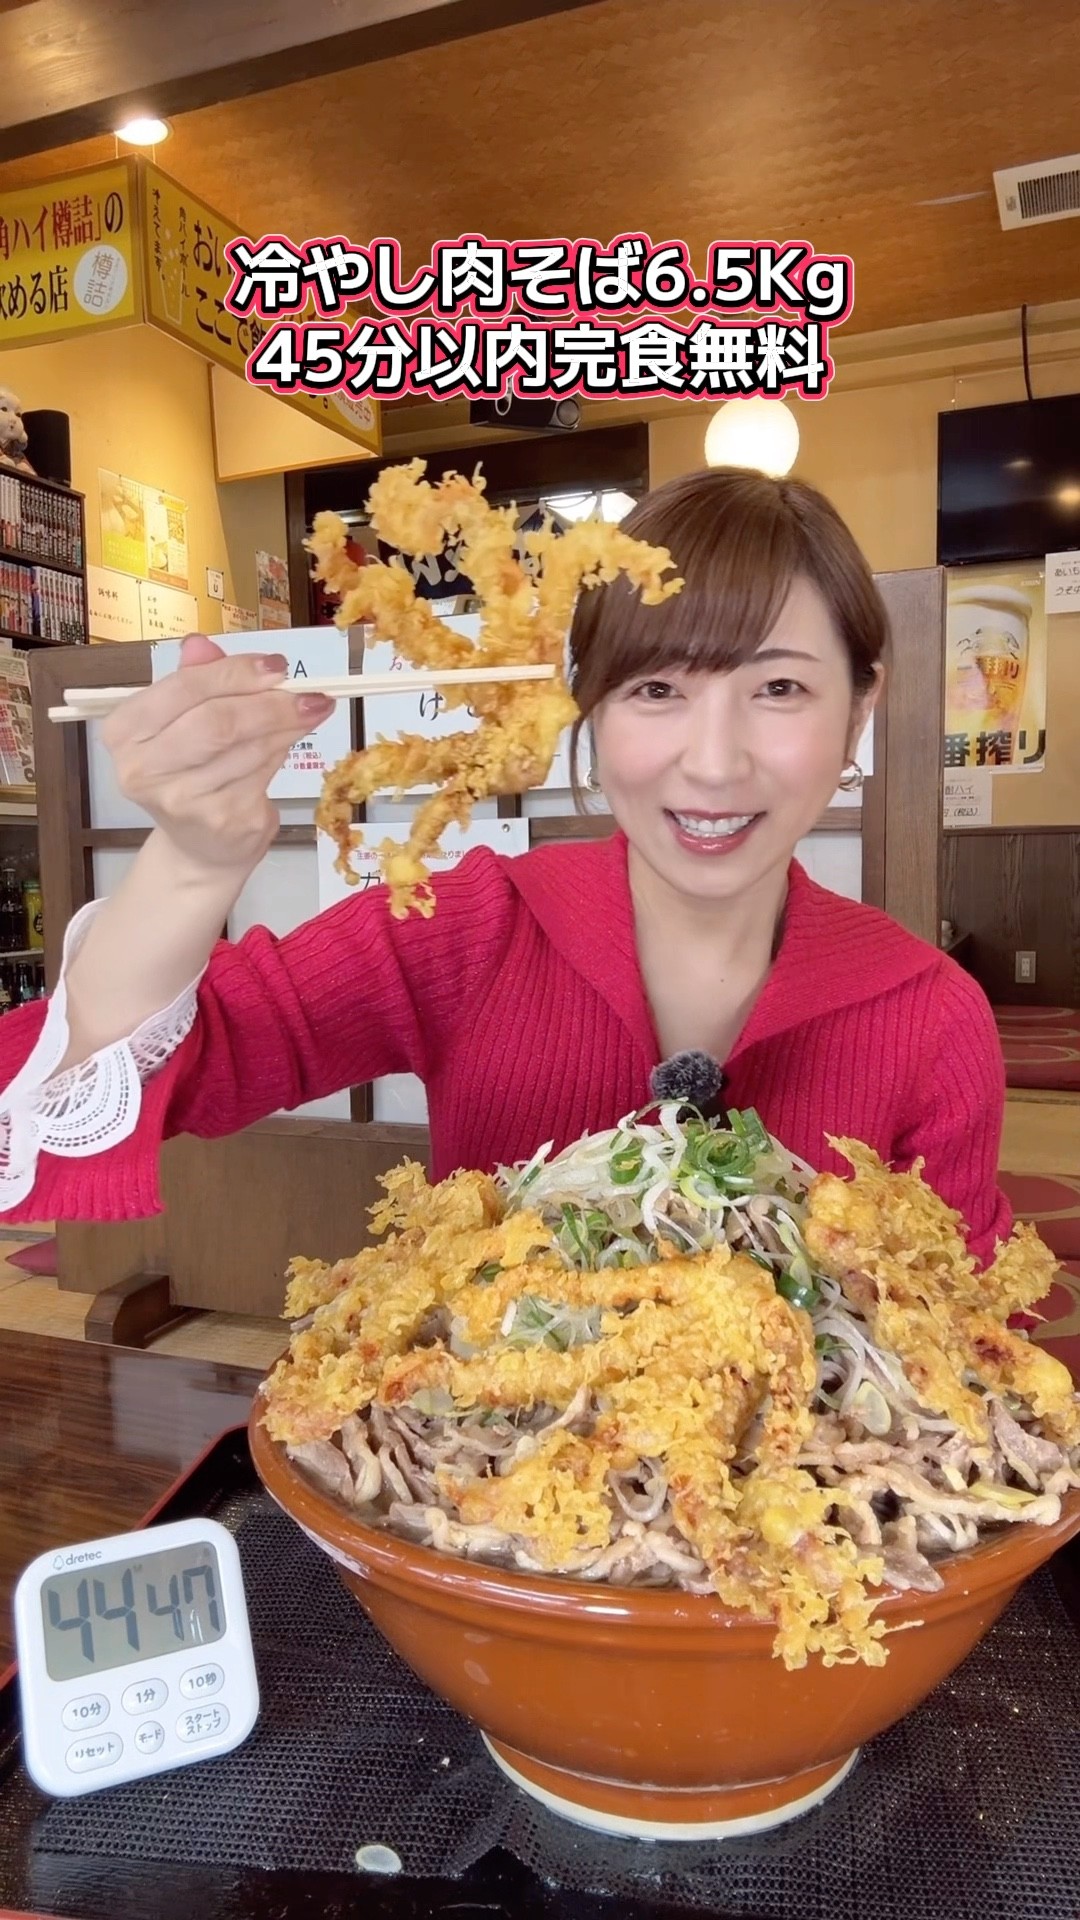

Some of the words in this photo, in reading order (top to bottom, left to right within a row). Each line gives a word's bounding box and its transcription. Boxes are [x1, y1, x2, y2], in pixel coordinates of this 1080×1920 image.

[65, 1550, 103, 1566] dretec
[188, 1671, 217, 1690] 10秒
[135, 1687, 157, 1704] 1分
[72, 1701, 102, 1719] 10分
[185, 1708, 220, 1726] スタート
[186, 1716, 222, 1736] ストップ
[138, 1728, 162, 1744] モード
[74, 1741, 115, 1759] リセット
